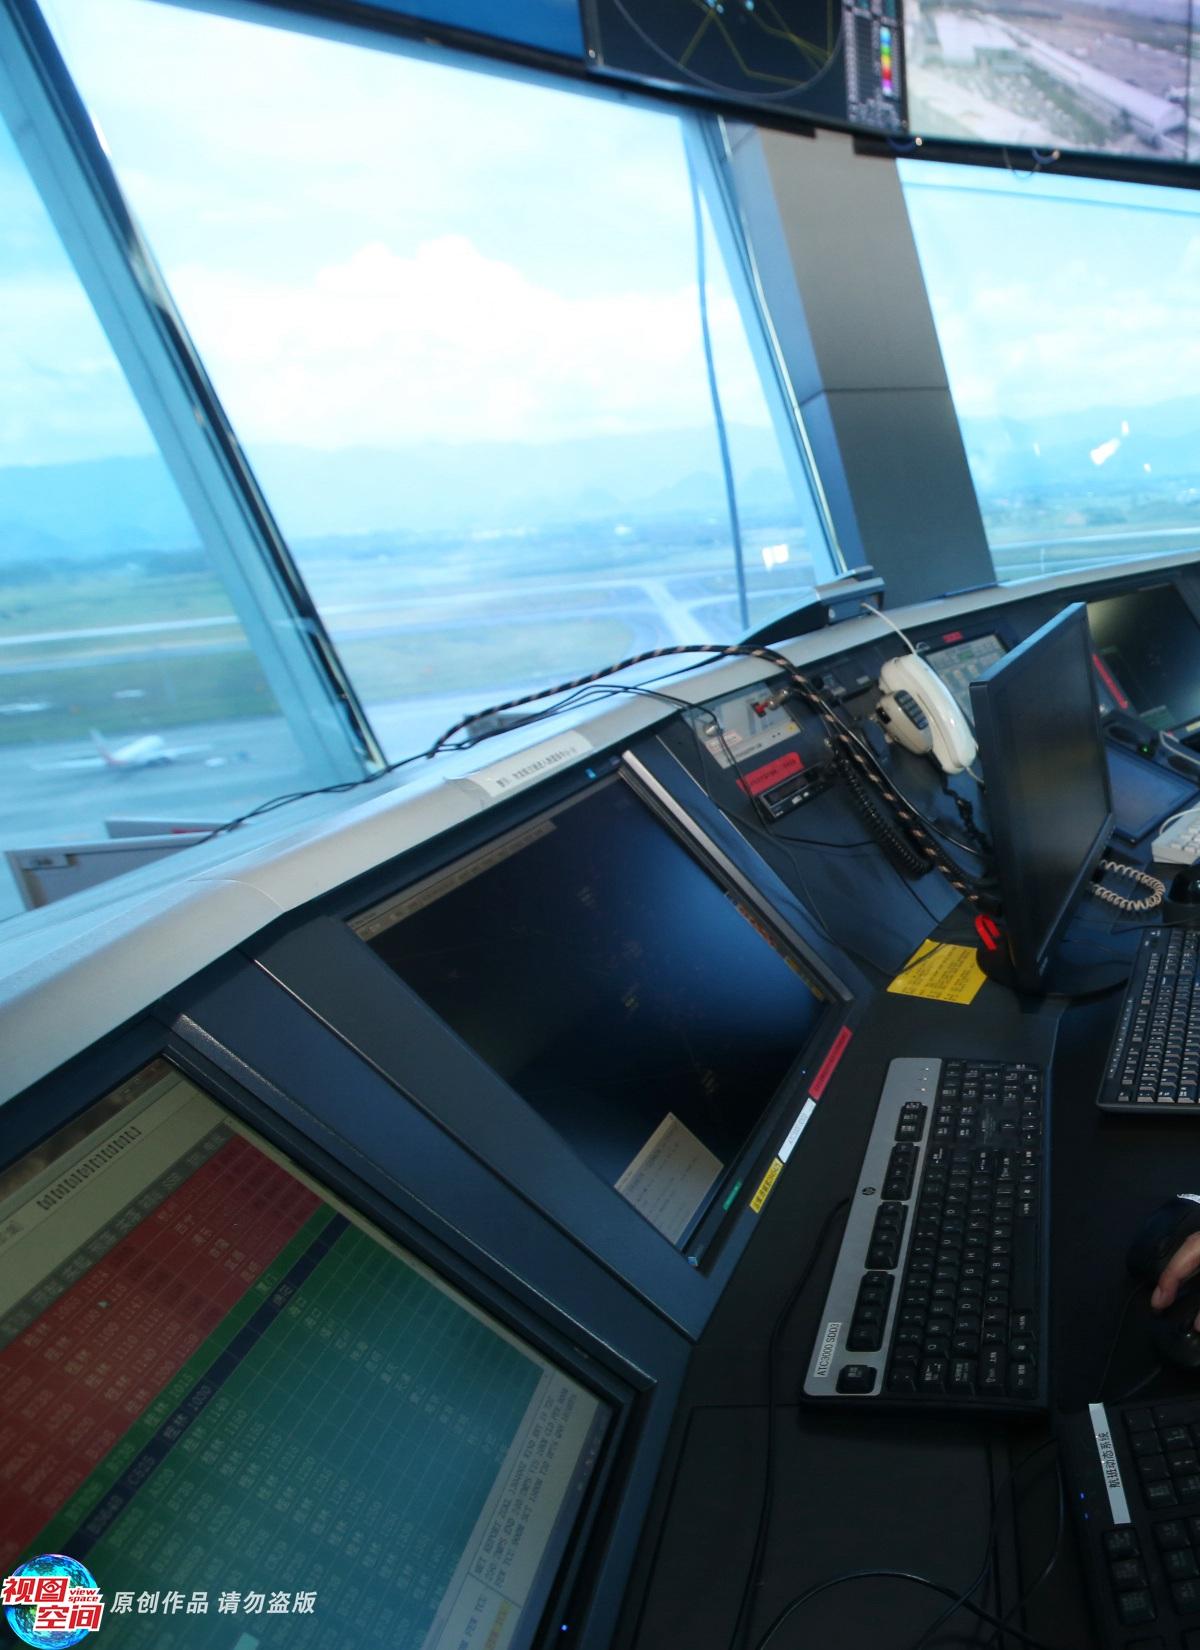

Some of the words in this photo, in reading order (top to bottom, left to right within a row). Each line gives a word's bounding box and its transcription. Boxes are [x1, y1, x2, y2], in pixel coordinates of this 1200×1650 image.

[817, 1343, 833, 1376] ATC3000
[1099, 1431, 1120, 1489] 航班动态系统
